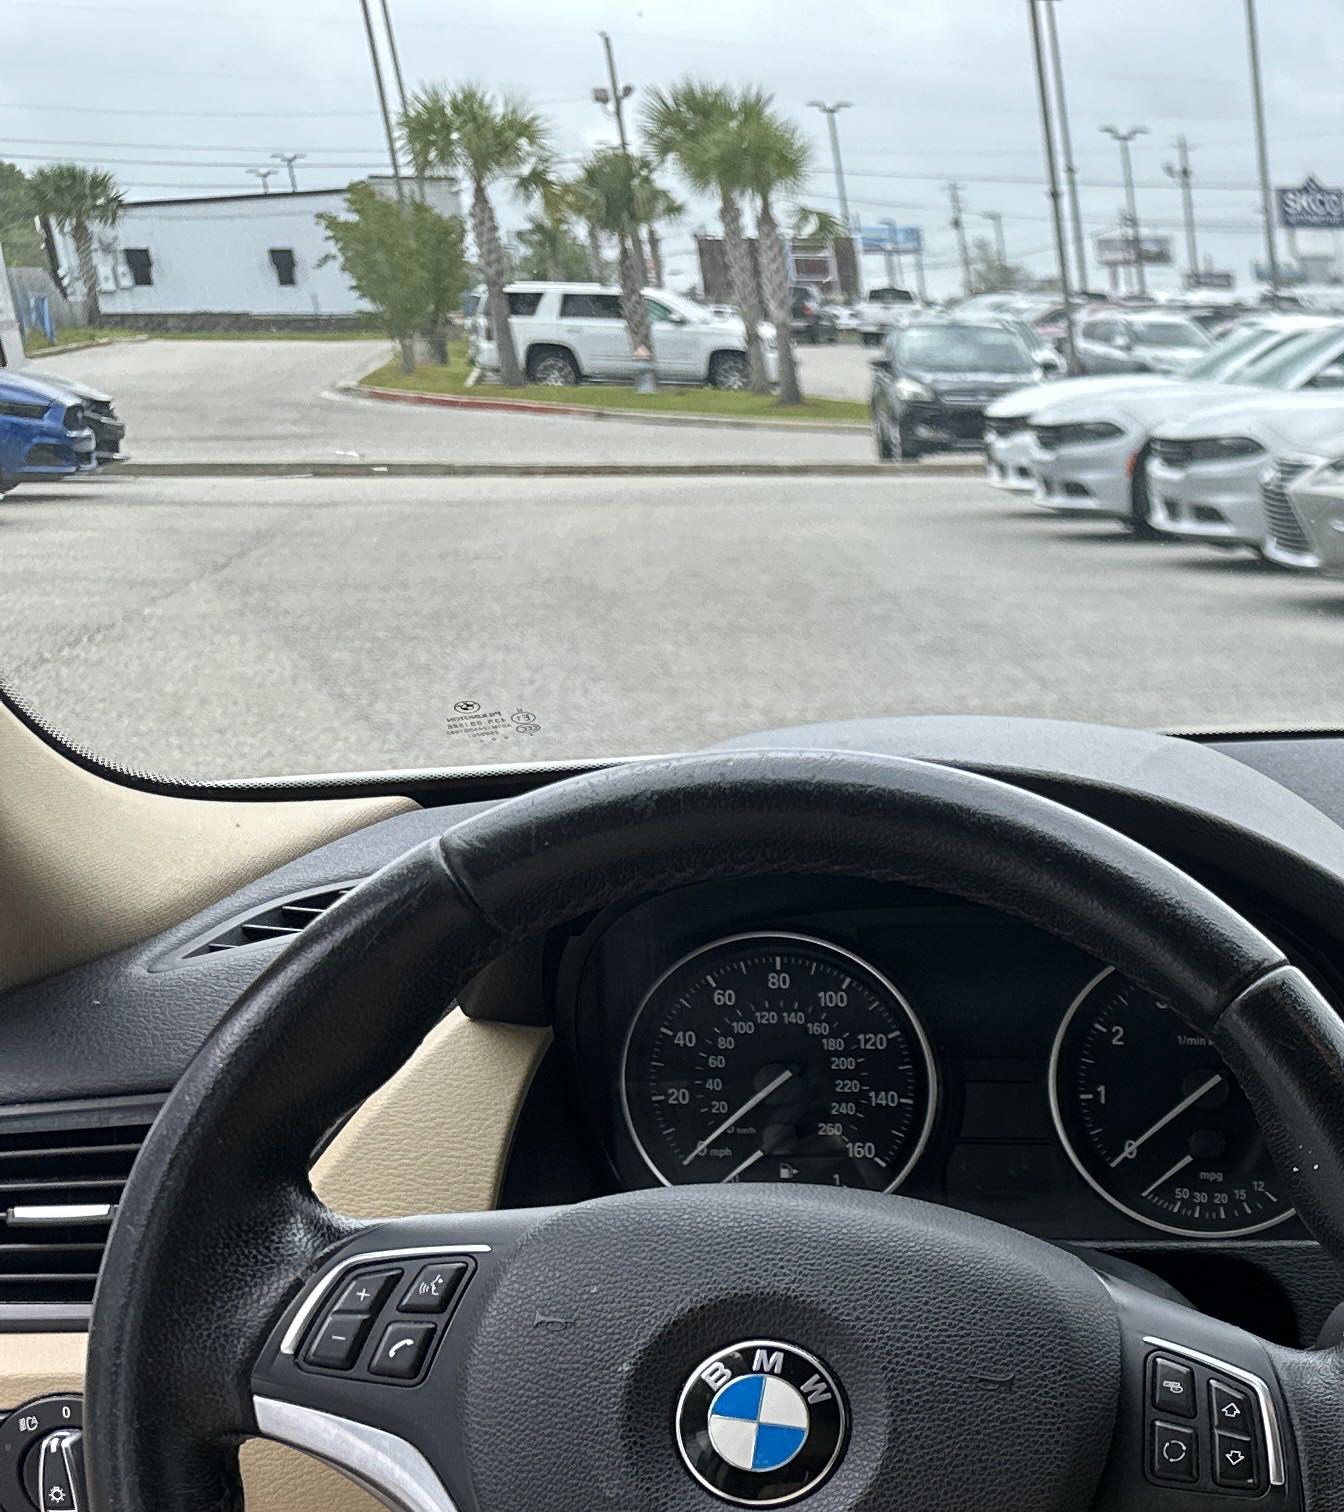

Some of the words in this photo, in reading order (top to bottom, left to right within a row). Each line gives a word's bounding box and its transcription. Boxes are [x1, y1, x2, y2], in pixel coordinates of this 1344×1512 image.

[768, 973, 790, 989] 80
[713, 990, 736, 1006] 60
[818, 991, 848, 1007] 100
[755, 1012, 778, 1024] 120
[782, 1012, 805, 1024] 140
[731, 1022, 755, 1034] 100
[807, 1022, 830, 1035] 160
[674, 1031, 696, 1047] 40
[857, 1033, 887, 1050] 120
[1111, 1026, 1125, 1045] 2
[717, 1036, 735, 1049] 80
[822, 1038, 845, 1051] 180
[708, 1055, 726, 1068] 60
[831, 1057, 856, 1070] 200
[705, 1078, 722, 1091] 40
[835, 1080, 860, 1093] 220
[667, 1088, 689, 1104] 20
[868, 1091, 898, 1107] 140
[1096, 1085, 1106, 1104] 1
[711, 1101, 728, 1113] 20
[831, 1102, 856, 1115] 240
[818, 1122, 842, 1135] 260
[710, 1147, 732, 1157] mph
[846, 1142, 876, 1158] 160
[1200, 1172, 1223, 1181] mpg
[1175, 1188, 1190, 1199] 50
[1194, 1192, 1208, 1203] 30
[1214, 1193, 1228, 1204] 20
[1234, 1190, 1246, 1200] 15
[1253, 1181, 1264, 1191] 12
[701, 1348, 832, 1404] BMW
